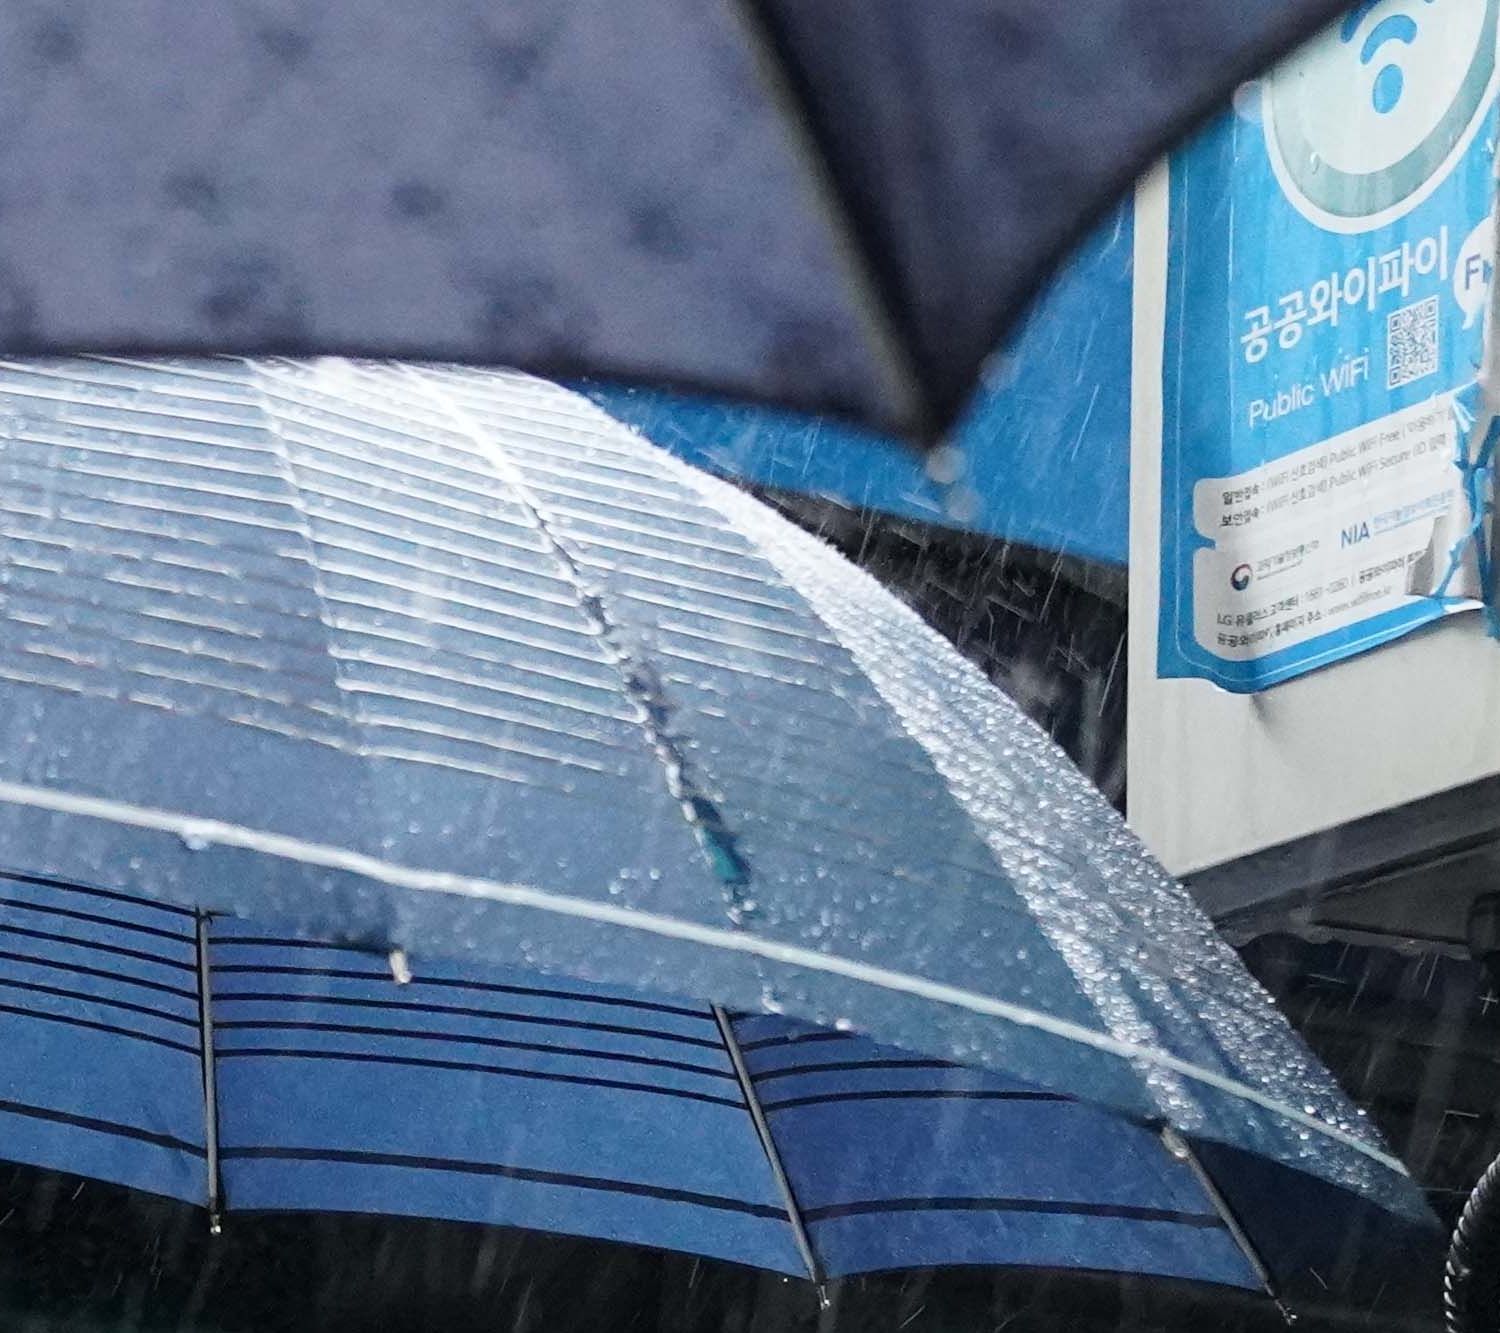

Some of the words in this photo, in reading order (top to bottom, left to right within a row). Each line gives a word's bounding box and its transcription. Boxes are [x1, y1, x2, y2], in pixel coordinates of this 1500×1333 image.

[1240, 225, 1448, 364] 공공와이파이
[1249, 380, 1315, 428] Public
[1320, 349, 1370, 397] WiFi
[1341, 521, 1370, 549] NIA
[1217, 613, 1232, 626] LG
